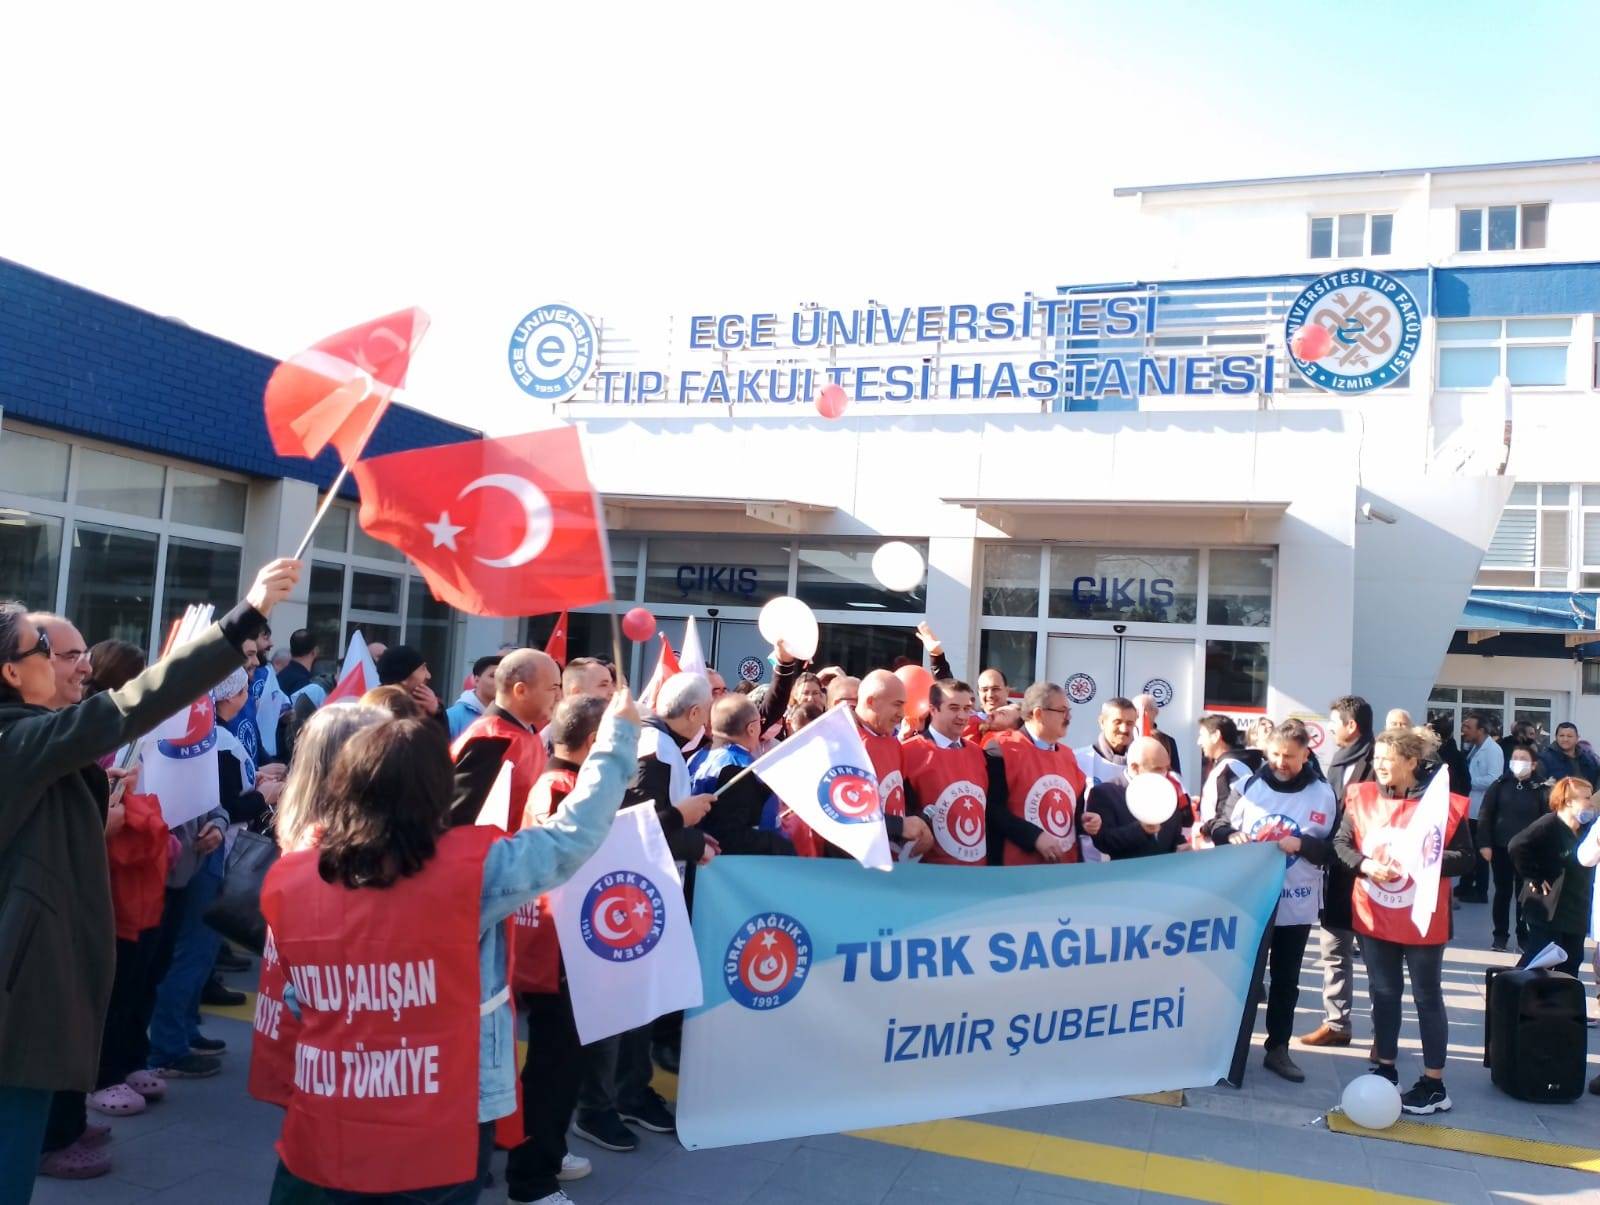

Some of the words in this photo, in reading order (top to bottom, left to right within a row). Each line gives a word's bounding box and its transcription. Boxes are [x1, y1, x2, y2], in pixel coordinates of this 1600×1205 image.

[690, 313, 776, 349] EGE
[791, 284, 1158, 347] ÜNİVERSİTESİ
[1287, 272, 1366, 336] NİVERSİTESİ
[1373, 275, 1396, 293] TIP
[1389, 293, 1422, 374] FAKÜLTESİ
[513, 348, 533, 386] EGE
[599, 371, 663, 405] TIP
[680, 357, 931, 405] FAKÜLTESİ
[949, 344, 1275, 400] HASTANESİ
[1332, 376, 1373, 389] İZMİR
[676, 565, 757, 597] ÇIKIŞ
[725, 937, 746, 985] TÜRK
[836, 928, 974, 982] TÜRK
[989, 916, 1238, 974] SAĞLIK-SEN
[290, 965, 342, 1011] UTLU
[346, 959, 436, 1024] ÇALIŞAN
[752, 995, 780, 1007] 1992
[883, 1011, 995, 1063] İZMİR
[1006, 987, 1185, 1057] ŞUBELERİ
[342, 1037, 439, 1098] TÜRKİYE
